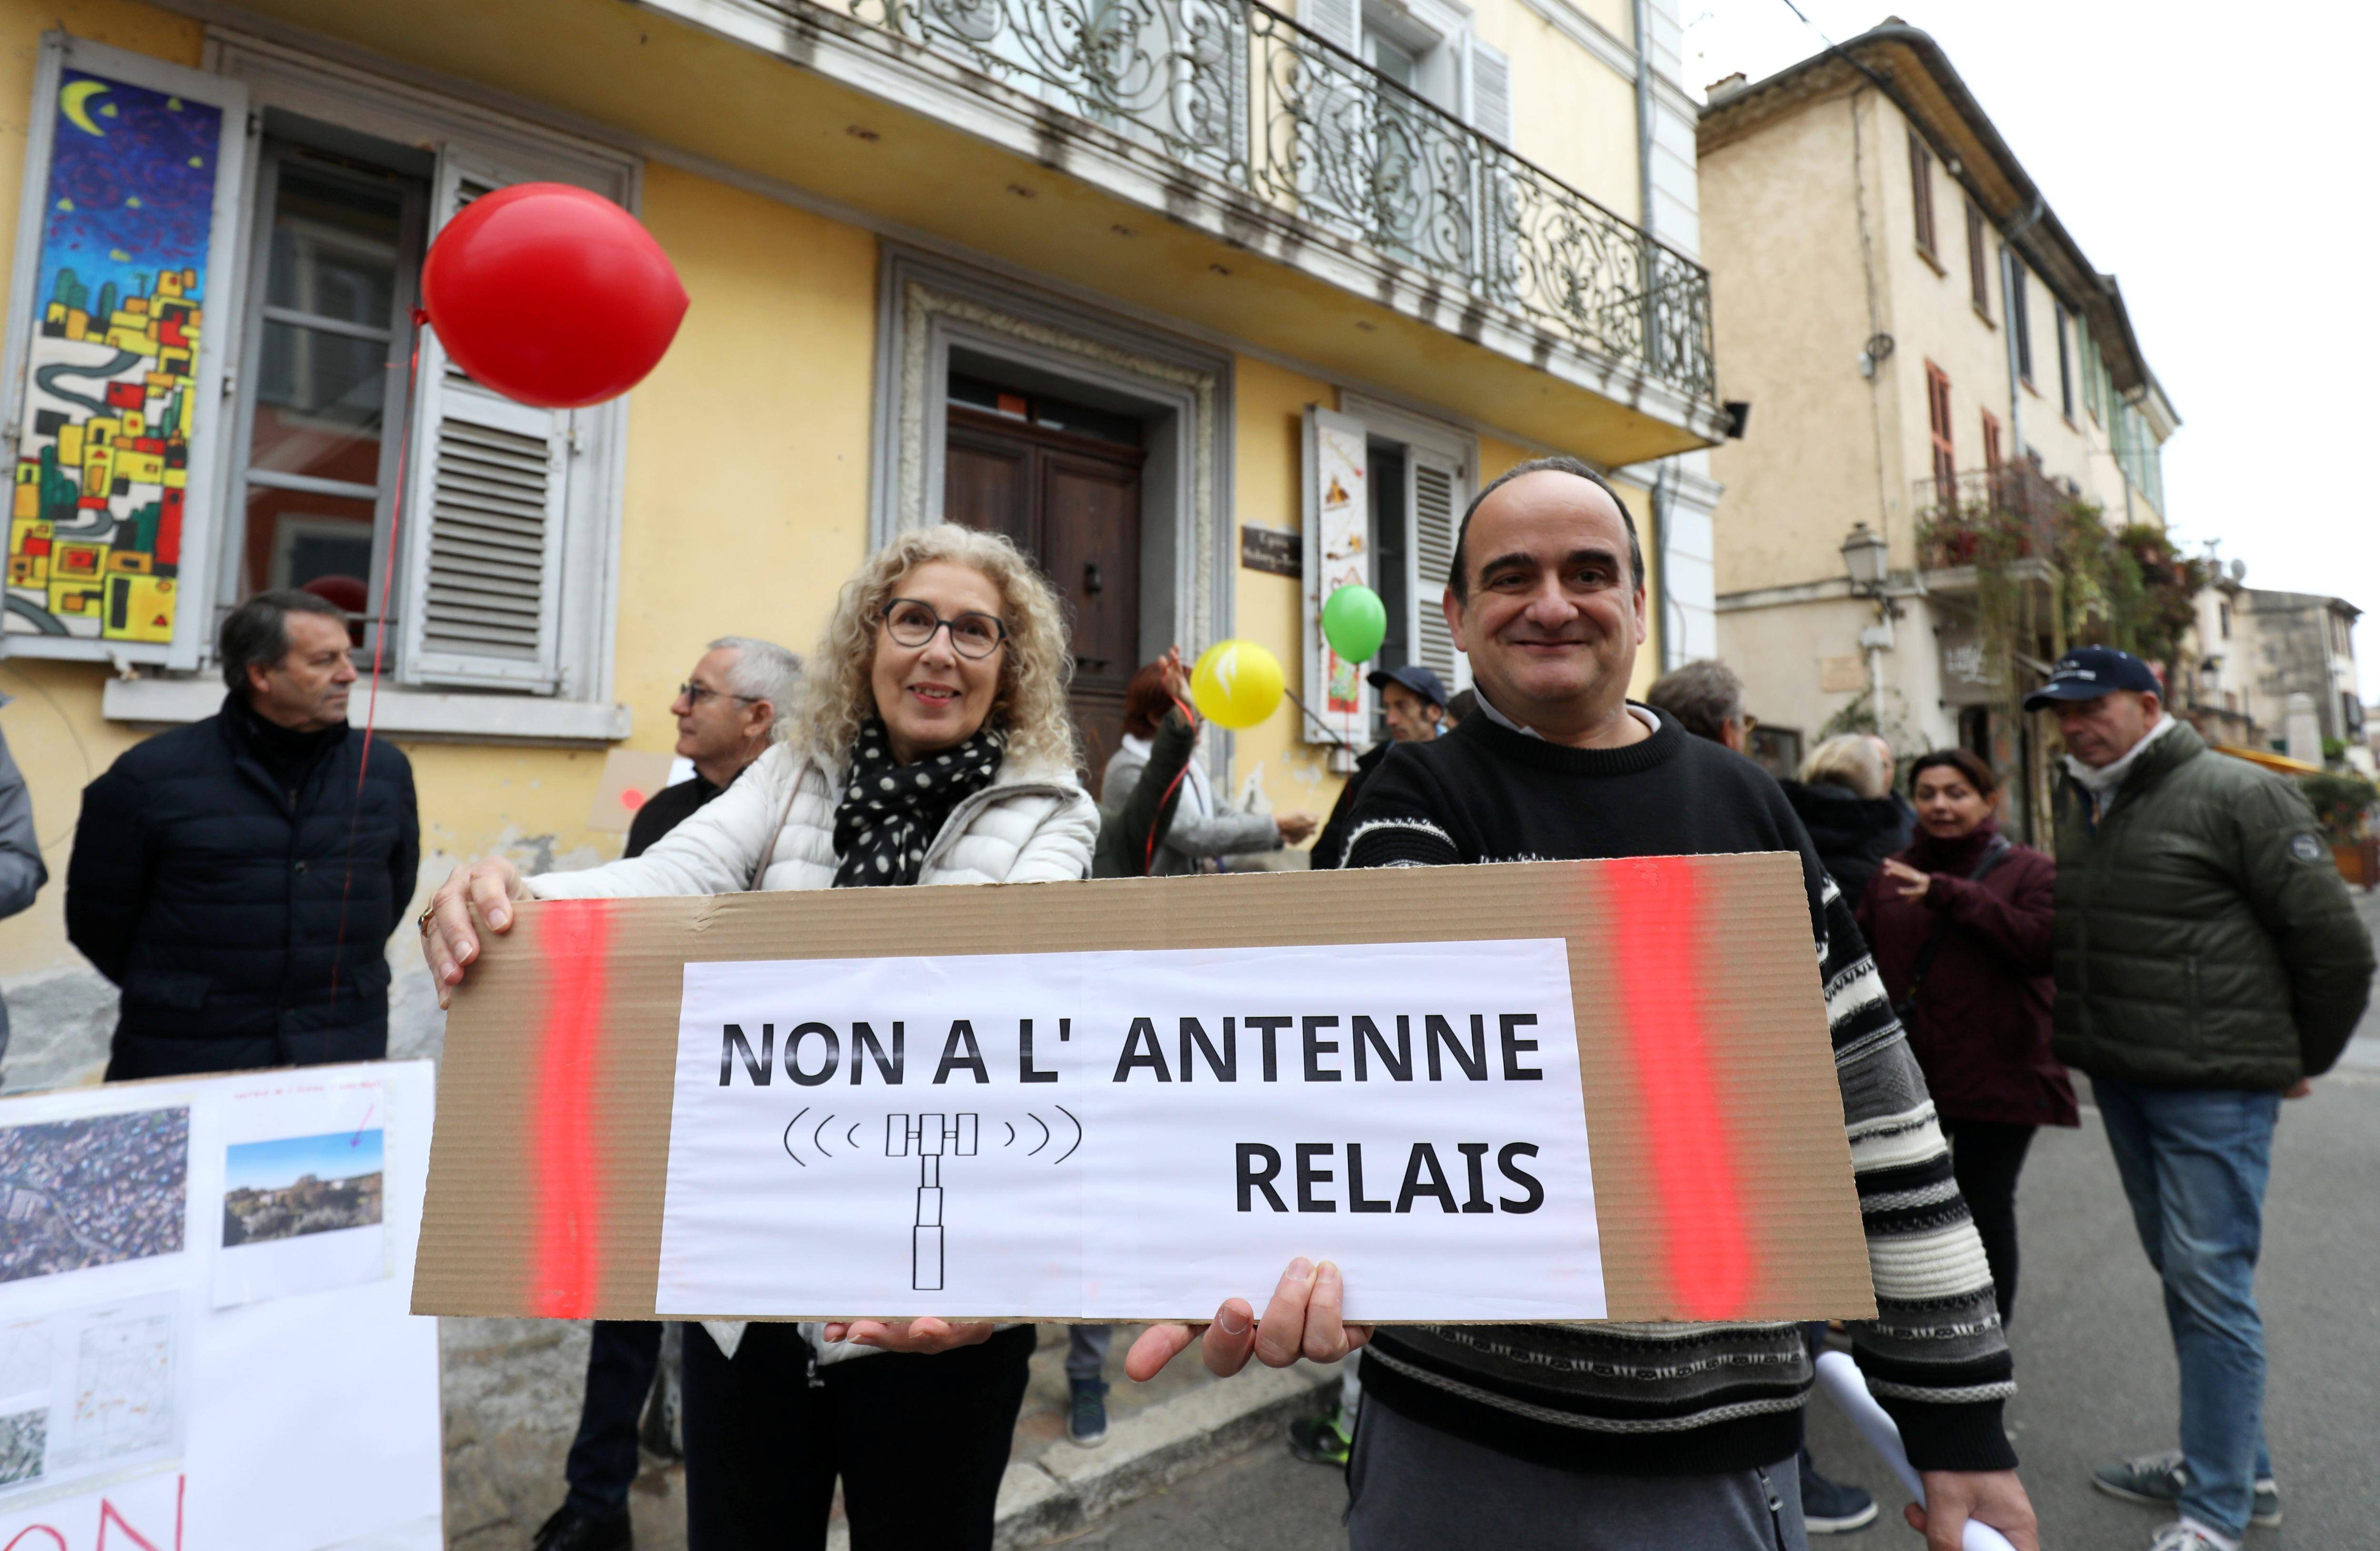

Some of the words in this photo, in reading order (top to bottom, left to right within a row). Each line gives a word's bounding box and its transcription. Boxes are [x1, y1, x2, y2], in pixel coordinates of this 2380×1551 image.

[719, 1021, 905, 1087] NON
[932, 1019, 990, 1084] A
[1020, 1018, 1071, 1083] L'
[1112, 1013, 1543, 1083] ANTENNE
[1235, 1141, 1545, 1215] RELAIS
